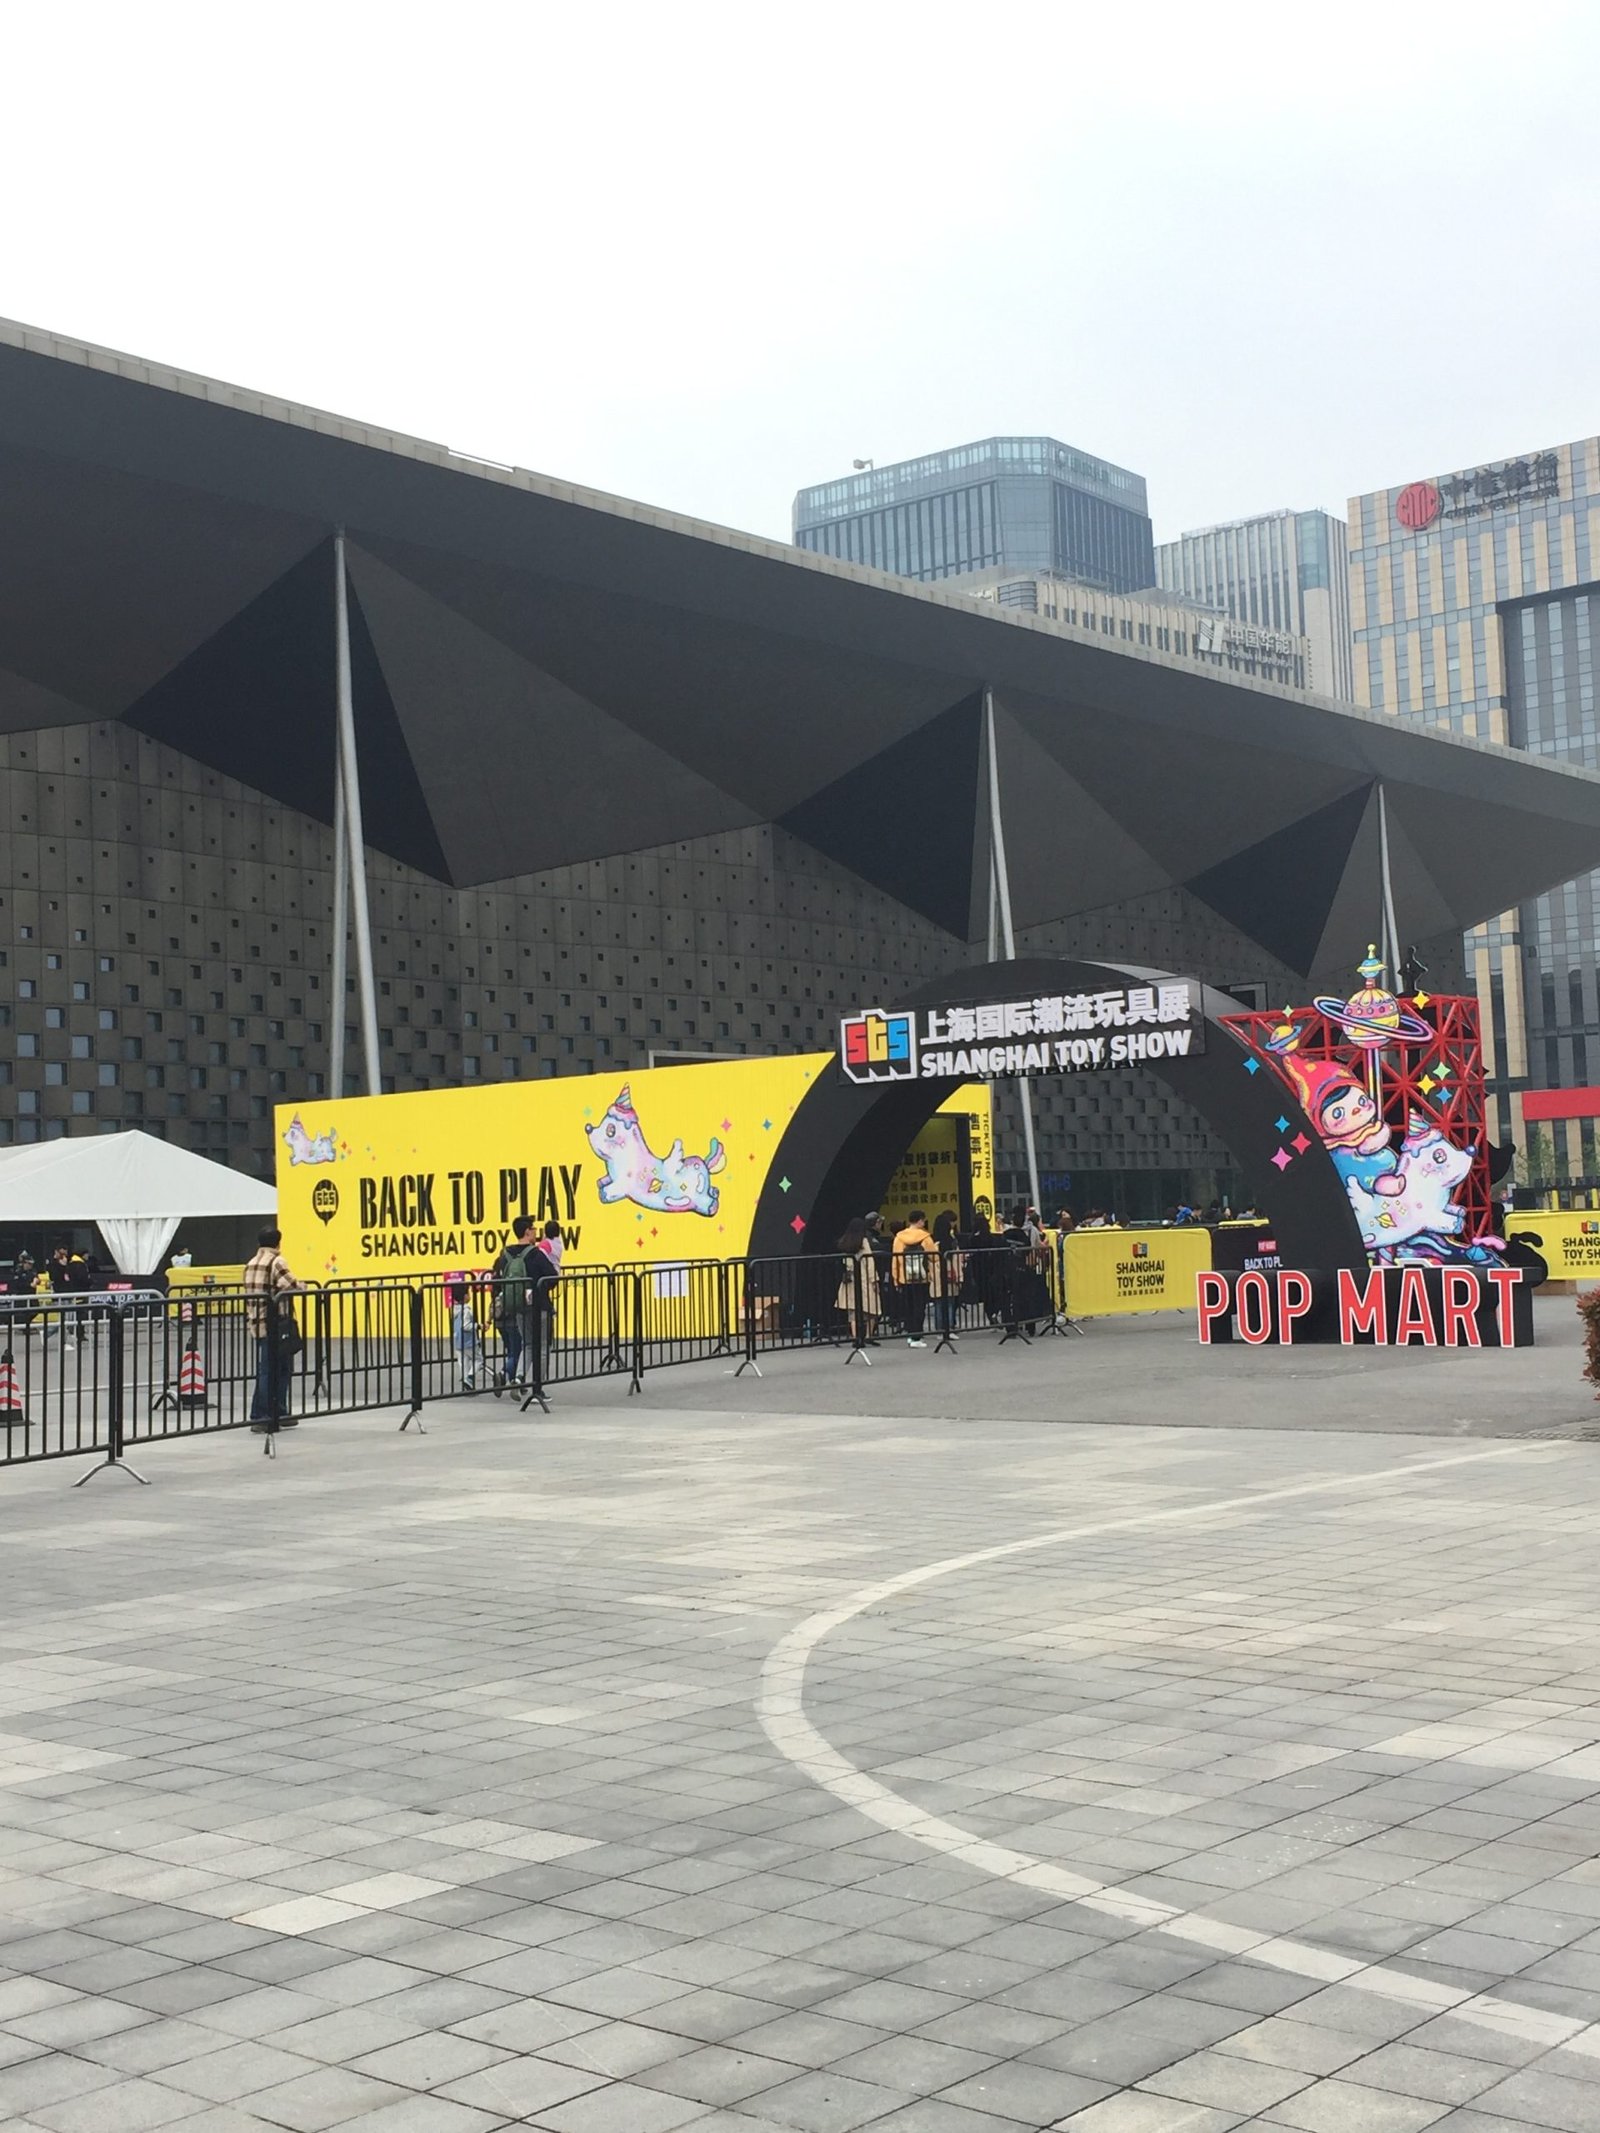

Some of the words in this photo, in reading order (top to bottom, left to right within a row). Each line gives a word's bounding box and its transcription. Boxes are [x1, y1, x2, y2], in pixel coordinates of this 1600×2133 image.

[920, 984, 1191, 1046] 上海国际潮流玩具展
[920, 1042, 1051, 1078] SHANGHAI
[1054, 1037, 1105, 1066] TOY
[1109, 1029, 1192, 1062] SHOW
[982, 1112, 992, 1179] TICKETING
[359, 1173, 437, 1229] BACK
[448, 1170, 485, 1226] TO
[499, 1164, 582, 1224] PLAY
[361, 1231, 465, 1258] SHANGHAI
[472, 1229, 510, 1255] TOY
[1244, 1258, 1263, 1270] BACK
[1263, 1256, 1273, 1269] TO
[1563, 1250, 1583, 1259] TOY
[1116, 1260, 1164, 1275] SHANGHAI
[1117, 1276, 1134, 1289] TOY
[1136, 1274, 1164, 1287] SHOW
[1196, 1270, 1312, 1345] POP
[1337, 1268, 1523, 1348] MART
